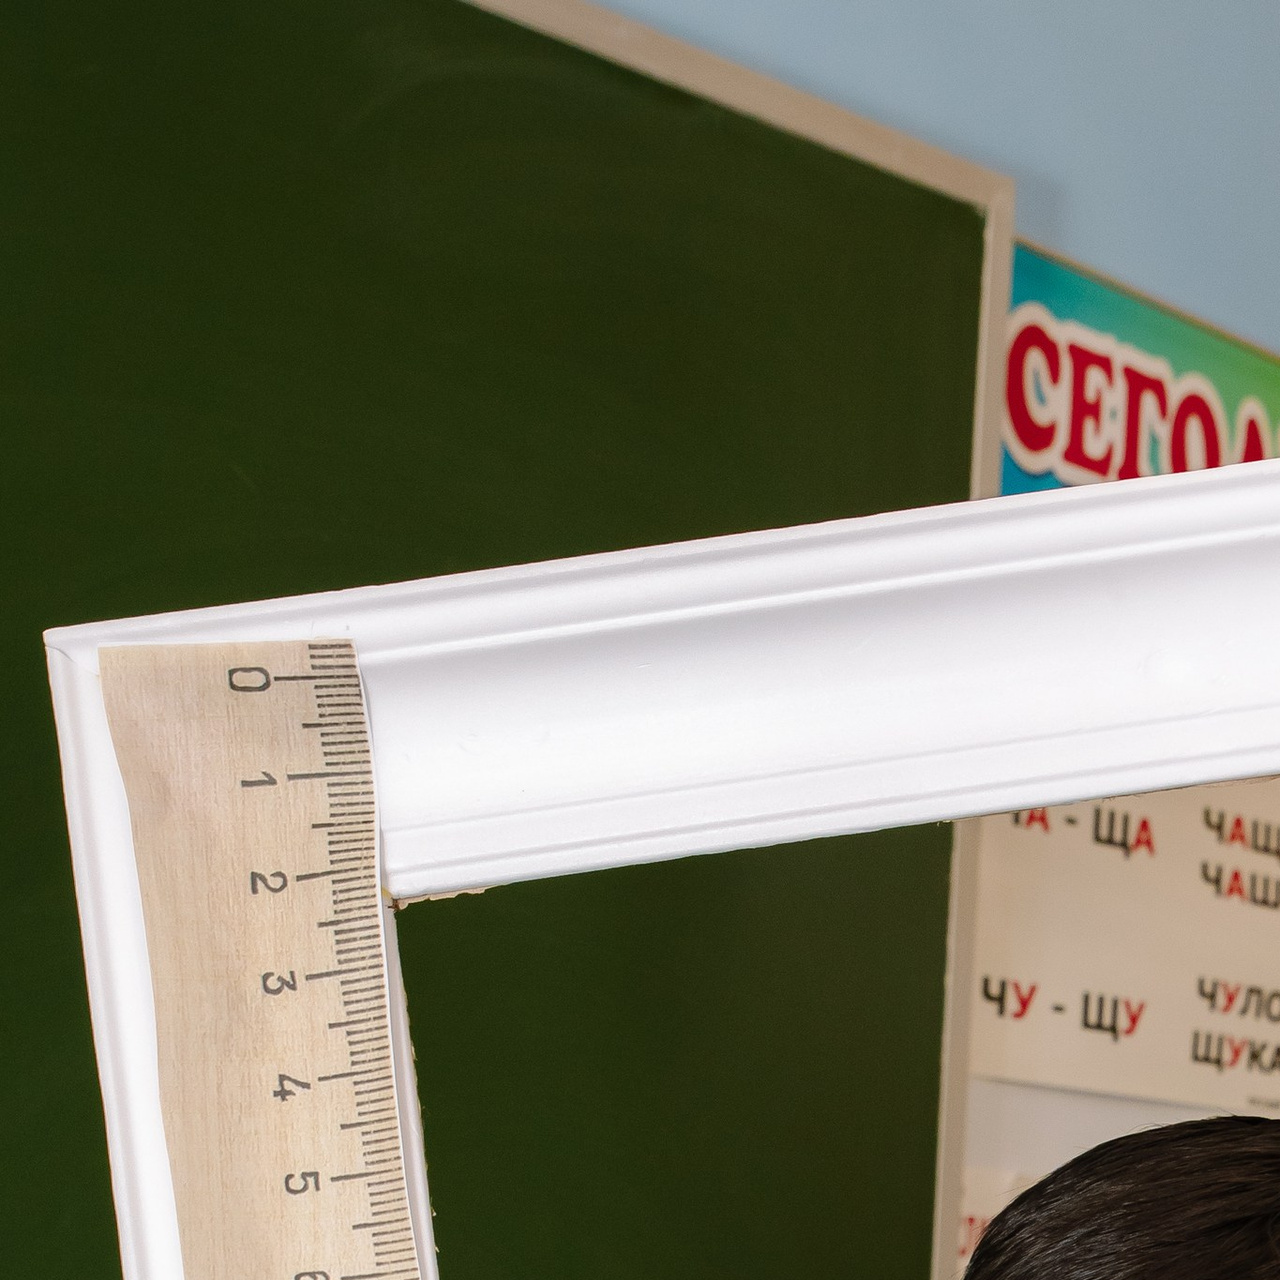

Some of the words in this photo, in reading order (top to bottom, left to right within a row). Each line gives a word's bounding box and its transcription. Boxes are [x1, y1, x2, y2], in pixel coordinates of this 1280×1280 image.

[227, 667, 271, 691] 0
[241, 771, 277, 787] 1
[1093, 806, 1156, 858] ЩА
[250, 871, 288, 895] 2
[262, 970, 297, 995] 3
[982, 975, 1037, 1019] ЧУ
[1081, 992, 1145, 1041] ЩУ
[273, 1073, 311, 1101] 4
[284, 1171, 320, 1194] 5
